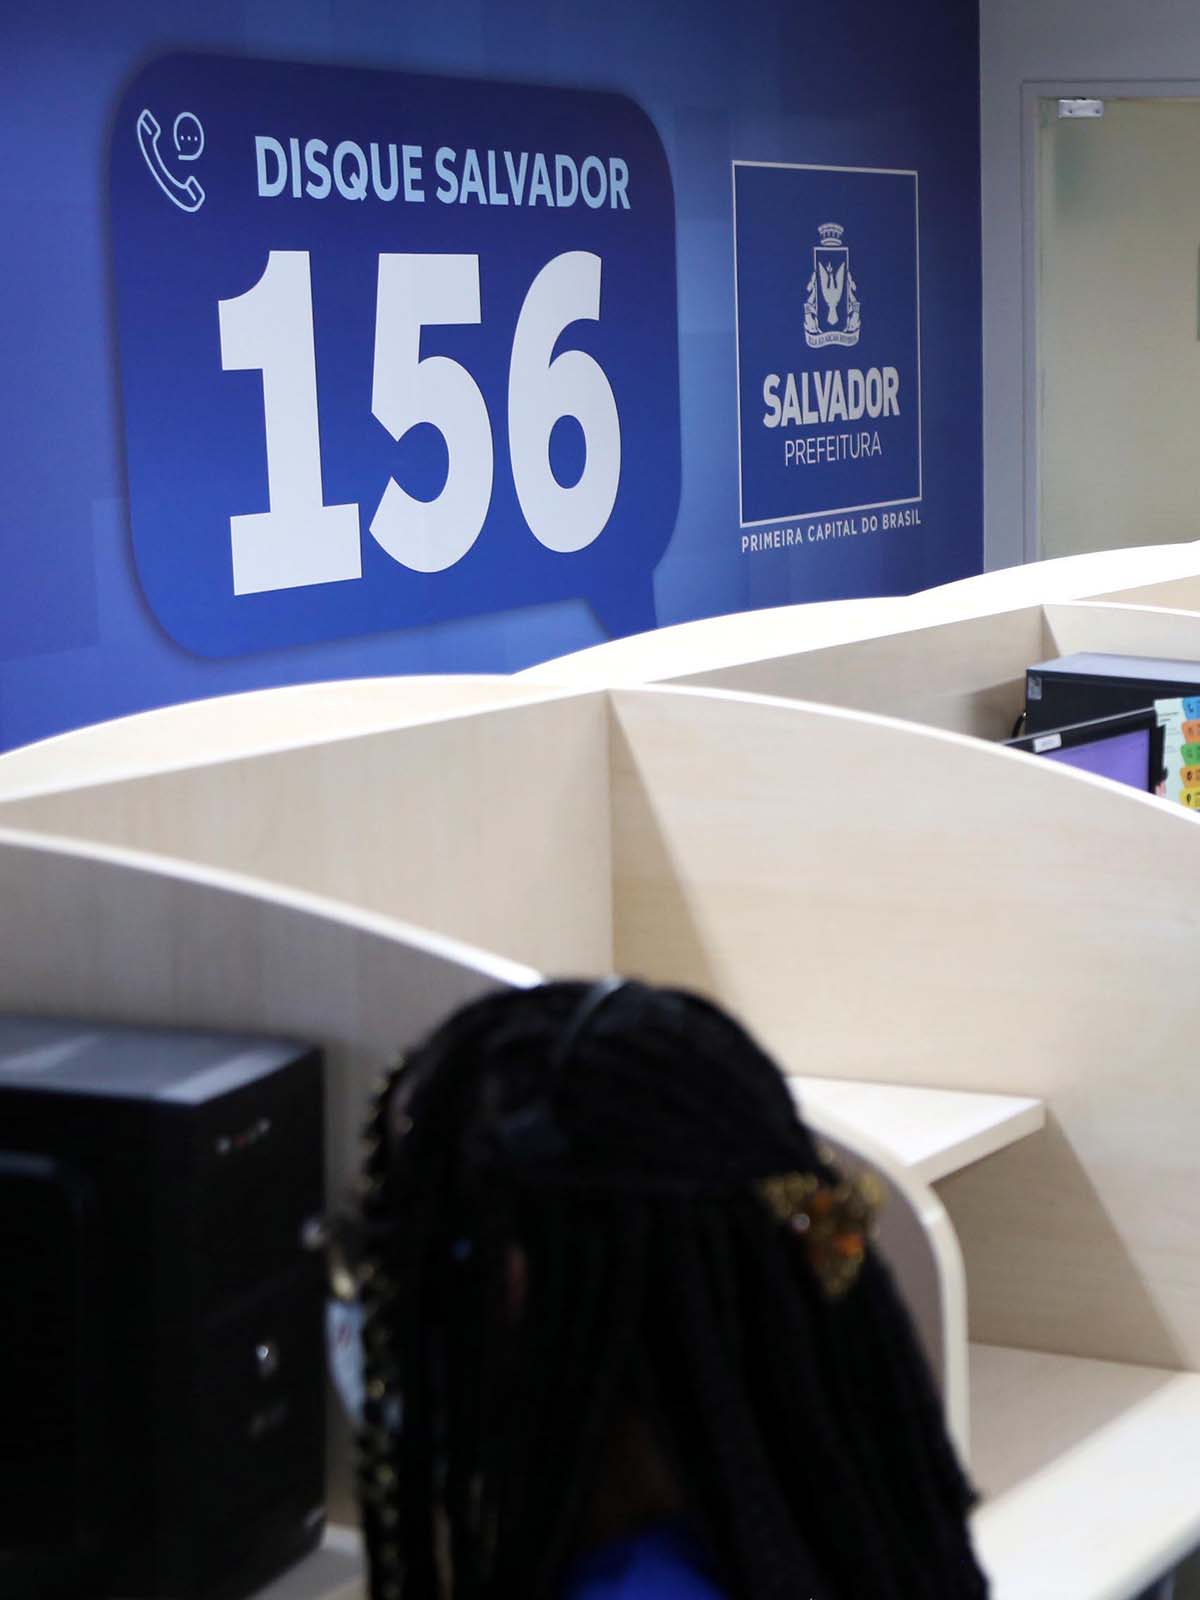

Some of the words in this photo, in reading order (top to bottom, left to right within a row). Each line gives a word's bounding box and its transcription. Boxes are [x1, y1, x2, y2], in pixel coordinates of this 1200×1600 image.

[256, 135, 425, 203] DISQUE
[435, 147, 630, 210] SALVADOR
[218, 250, 622, 597] 156
[763, 366, 900, 429] SALVADOR
[785, 431, 882, 466] PREFEITURA
[742, 528, 803, 553] PRIMEIRA
[808, 518, 857, 542] CAPITAL
[862, 517, 879, 534] DO
[882, 508, 921, 531] BRASIL
